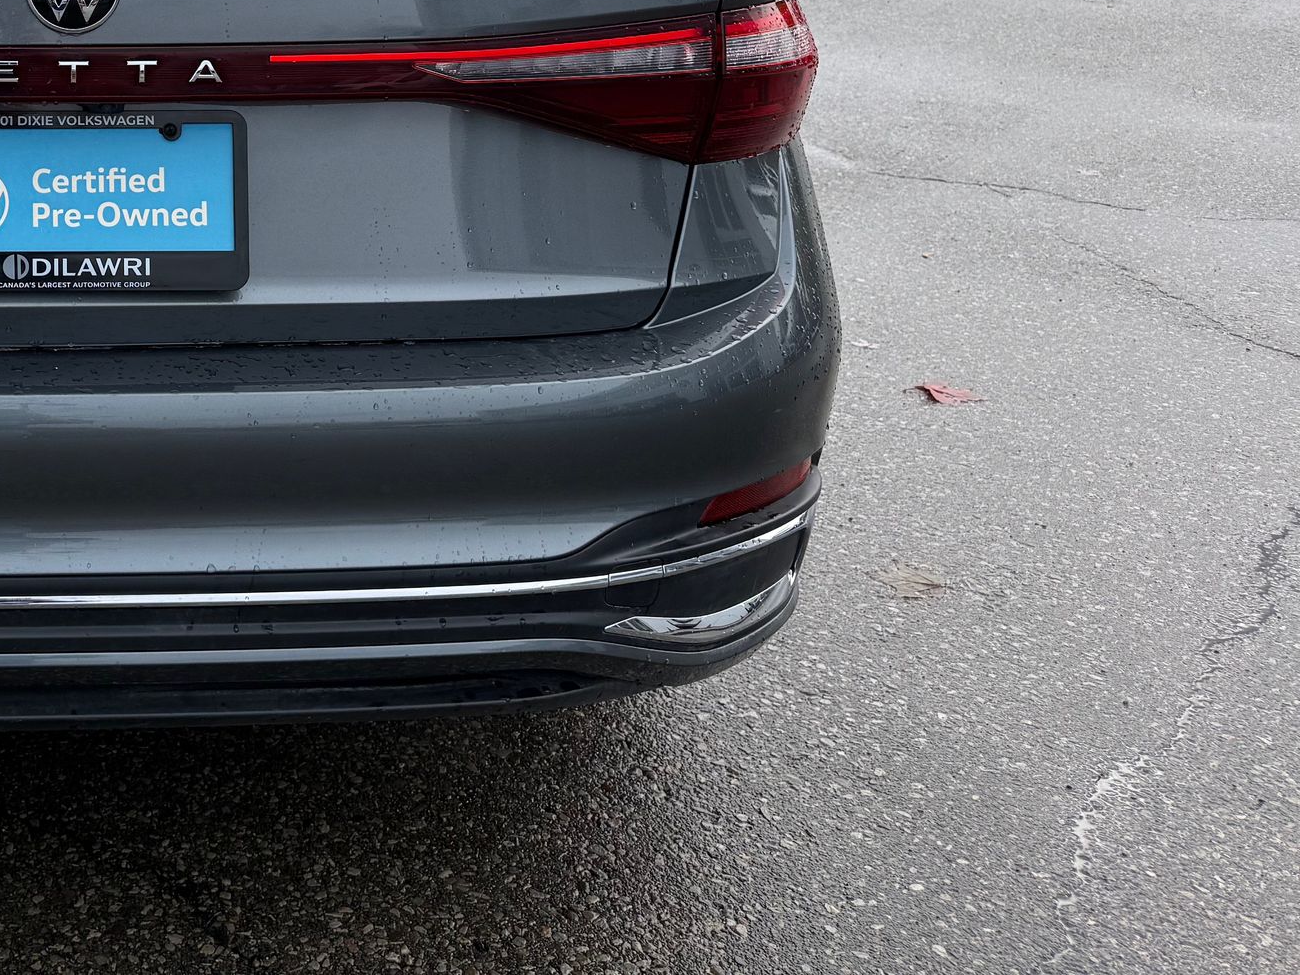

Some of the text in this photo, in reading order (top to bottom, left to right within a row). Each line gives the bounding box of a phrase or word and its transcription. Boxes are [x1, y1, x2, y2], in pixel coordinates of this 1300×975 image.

[17, 115, 54, 126] DIXIE
[57, 114, 155, 126] VOLKSWAGEN
[31, 166, 166, 194] Certified
[31, 200, 208, 228] Pre-Owned
[32, 257, 151, 277] DILAWRI
[37, 281, 71, 289] LARGEST
[72, 280, 122, 289] AUTOMOTIVE
[123, 280, 151, 288] GROUP
